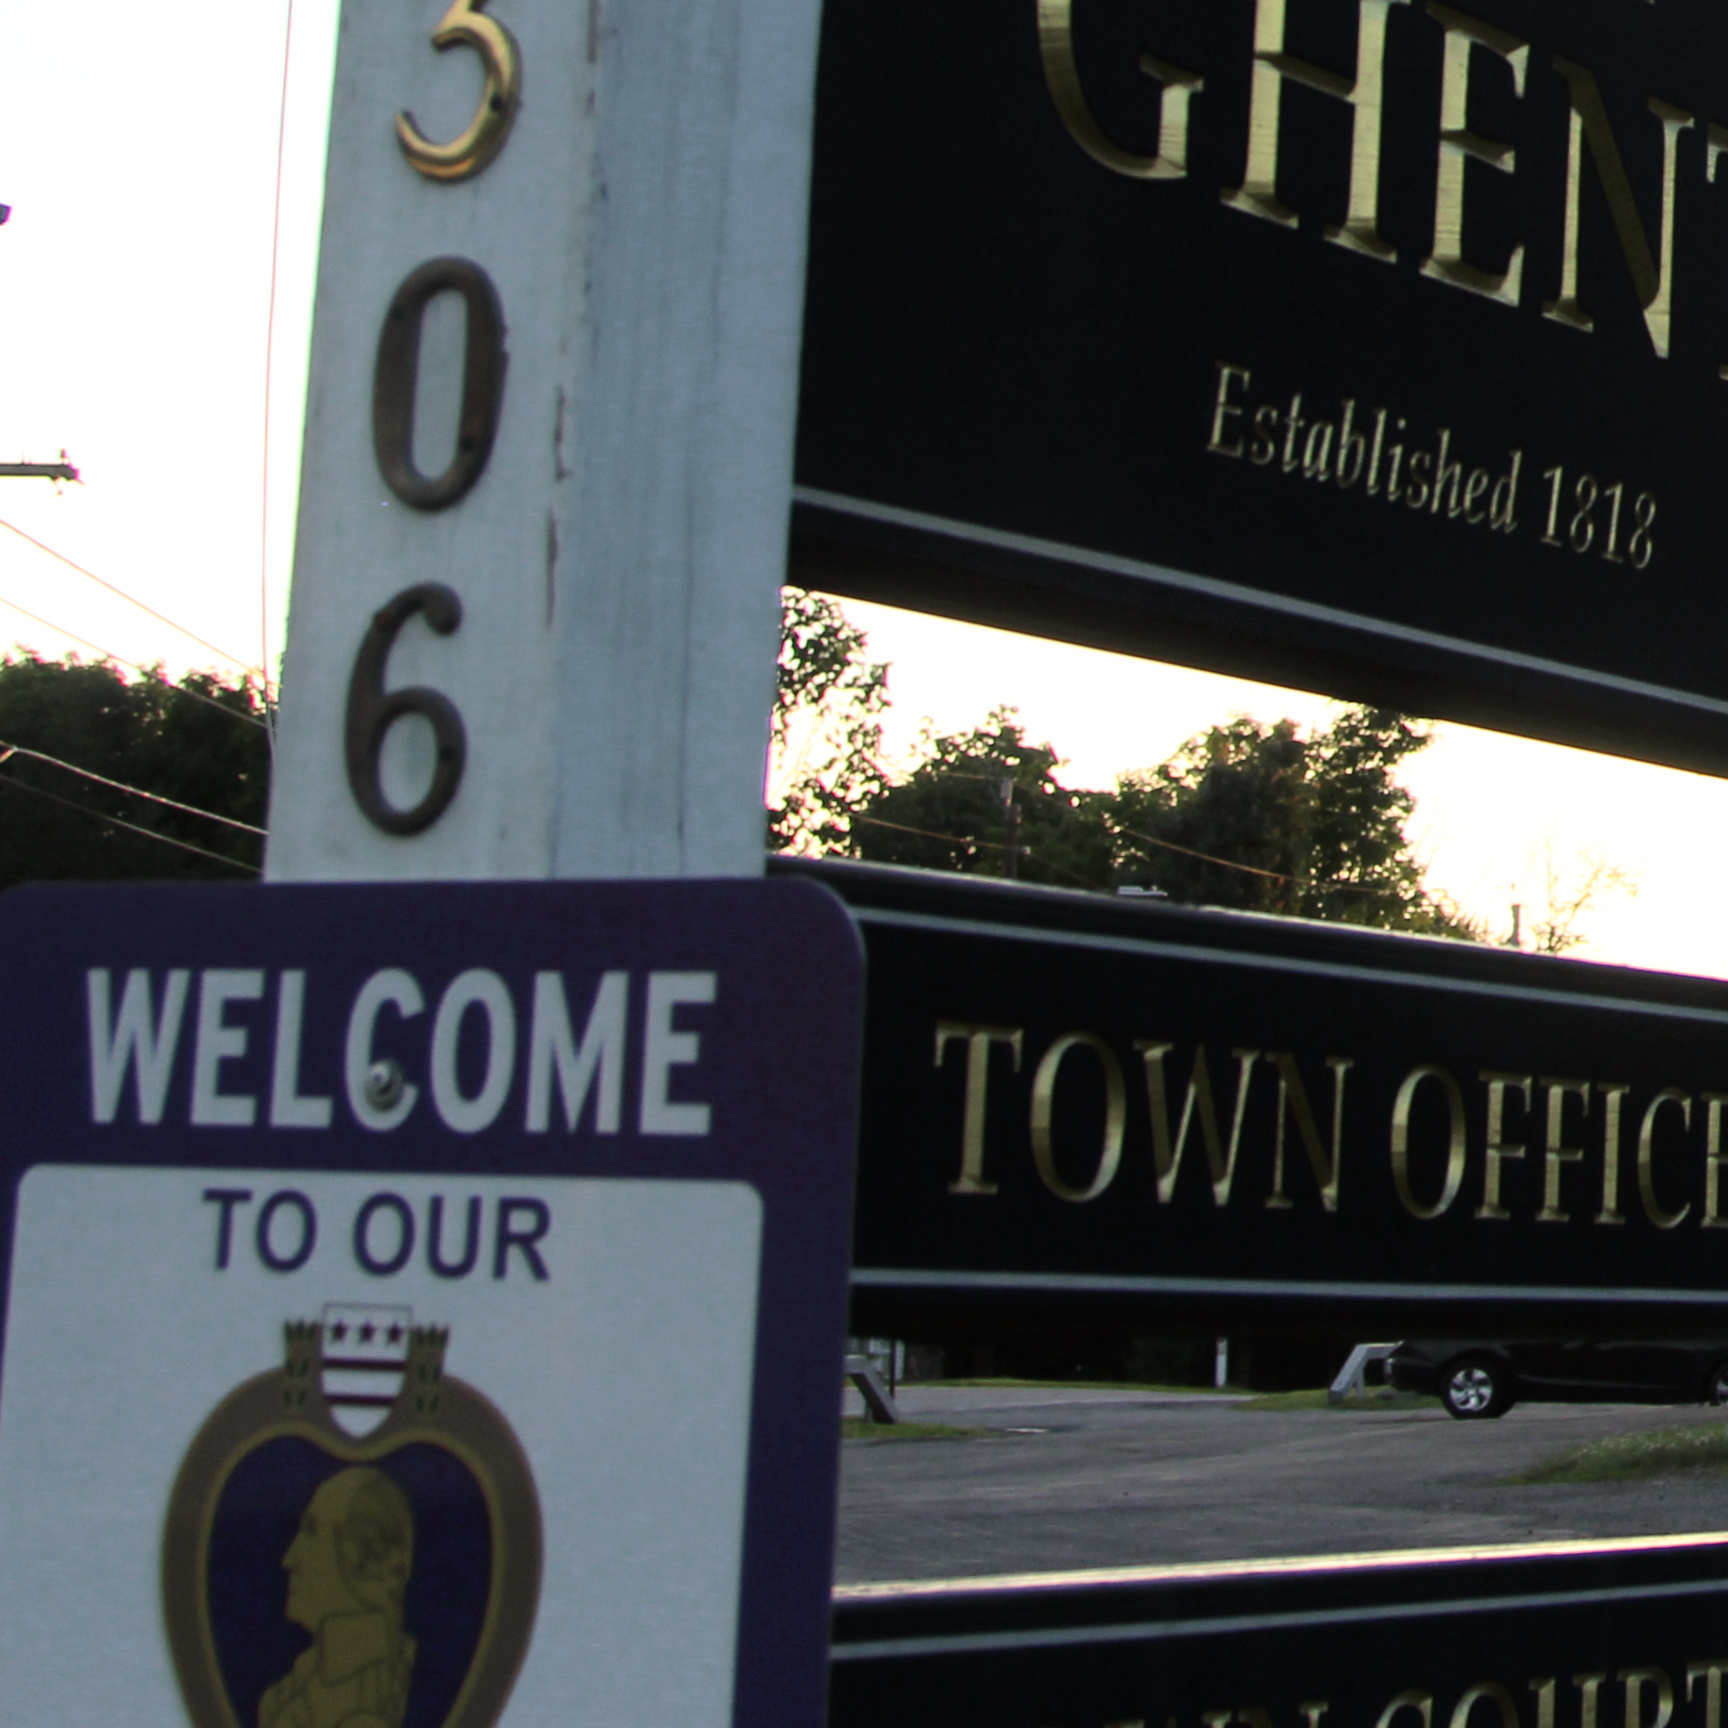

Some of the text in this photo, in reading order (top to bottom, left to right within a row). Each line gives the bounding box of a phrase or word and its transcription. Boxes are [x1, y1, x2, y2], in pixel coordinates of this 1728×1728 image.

[1205, 360, 1660, 570] Established 1818
[86, 966, 718, 1137] WELCOME
[933, 1021, 1353, 1214] TOWN
[202, 1187, 552, 1282] TO OUR
